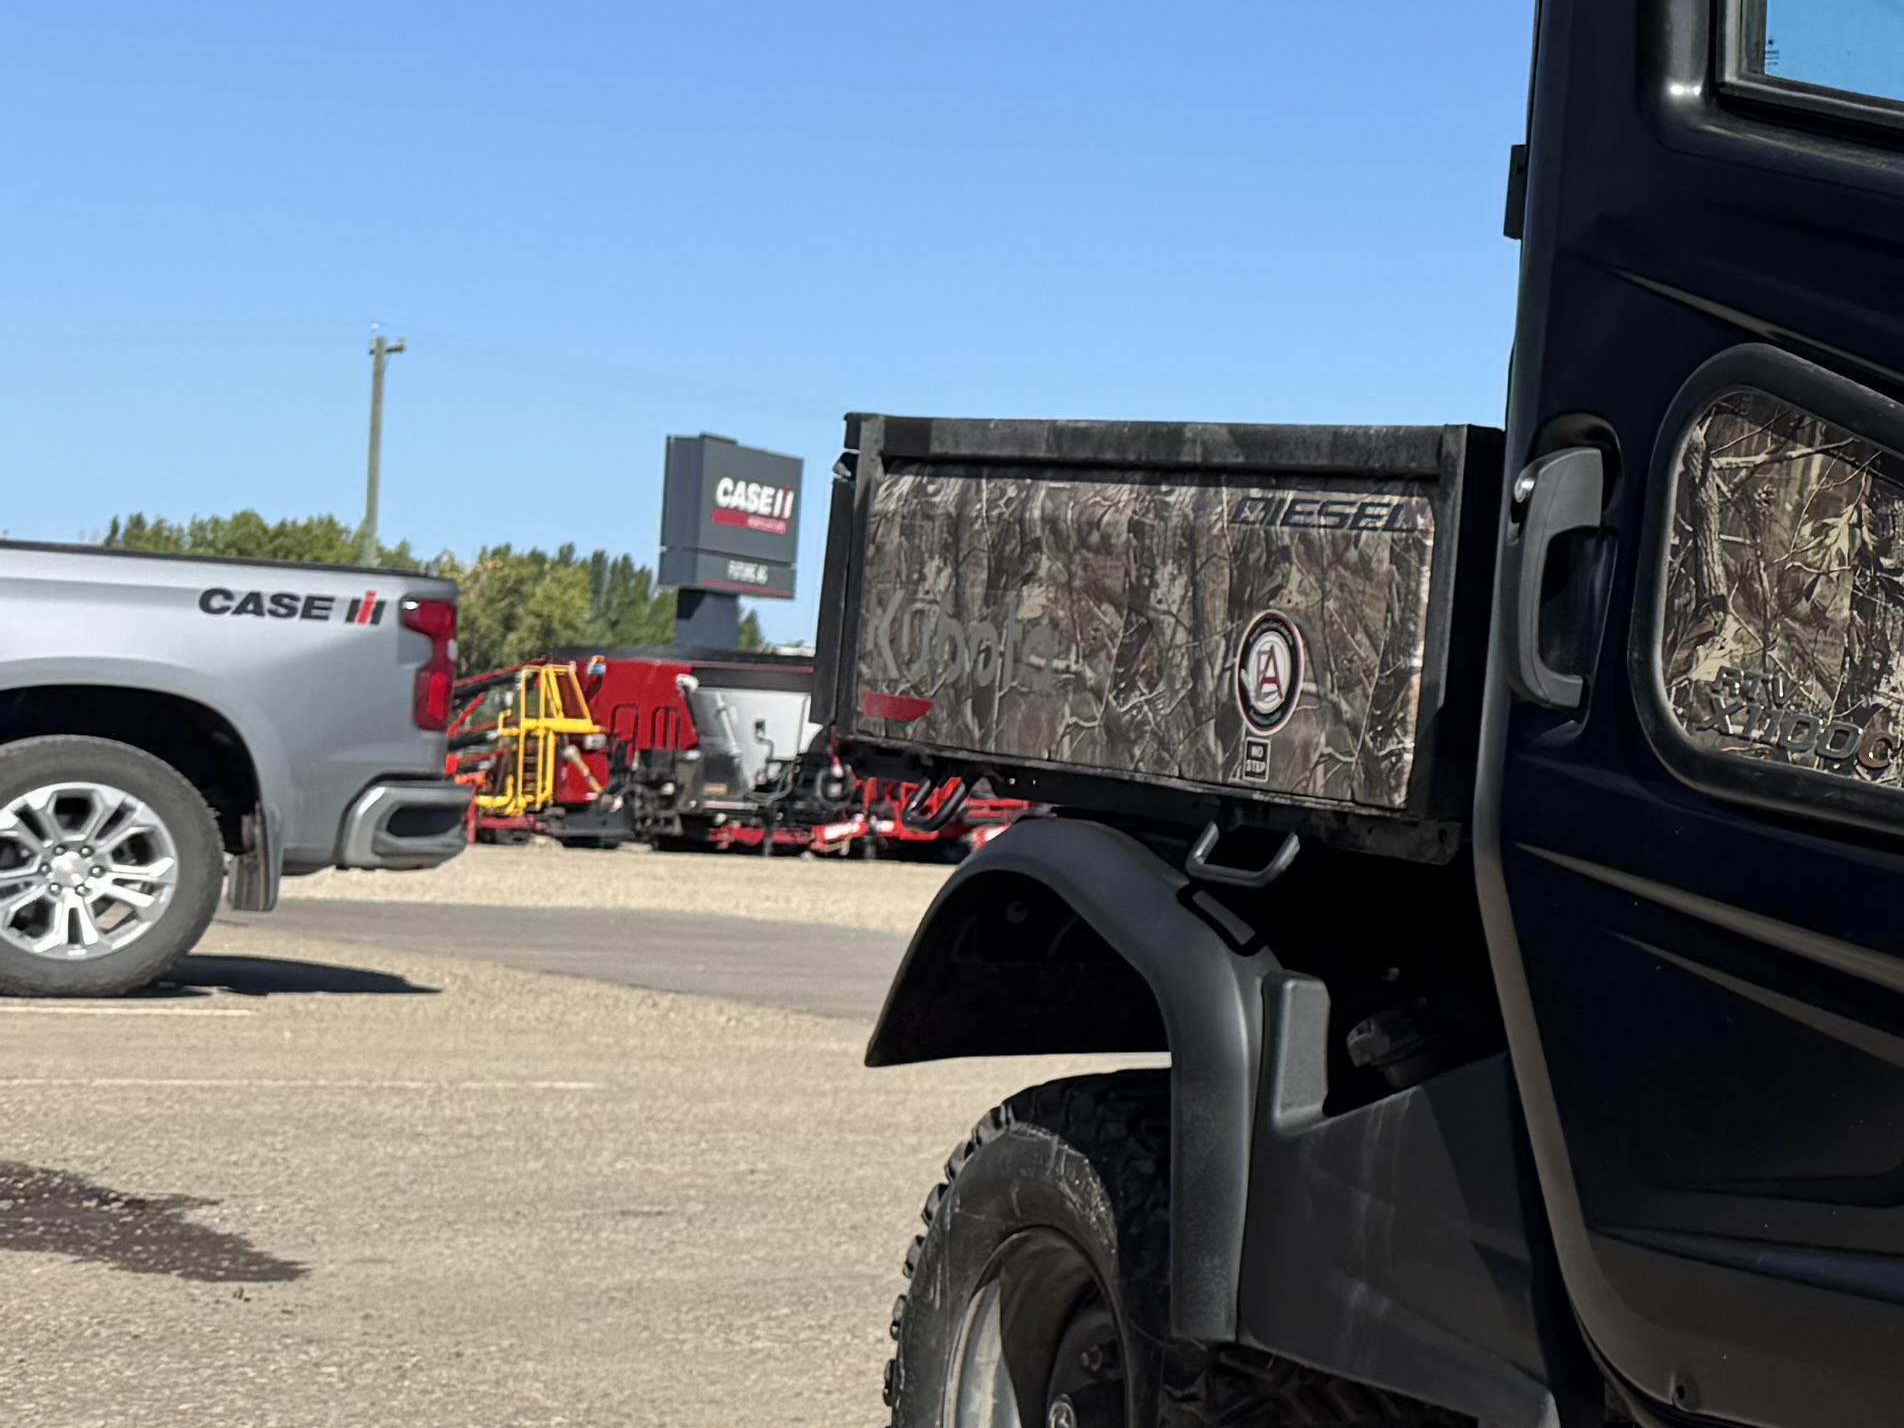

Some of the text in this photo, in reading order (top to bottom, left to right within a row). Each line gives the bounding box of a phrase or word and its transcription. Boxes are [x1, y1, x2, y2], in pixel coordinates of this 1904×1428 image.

[716, 477, 775, 514] CASE
[1230, 497, 1418, 532] DIESEL
[199, 588, 335, 620] CASE
[866, 587, 1058, 691] Kubota
[1712, 666, 1800, 708] RTV
[1696, 694, 1898, 768] X1100C
[1246, 759, 1266, 773] STEP
[1251, 746, 1264, 759] NO
